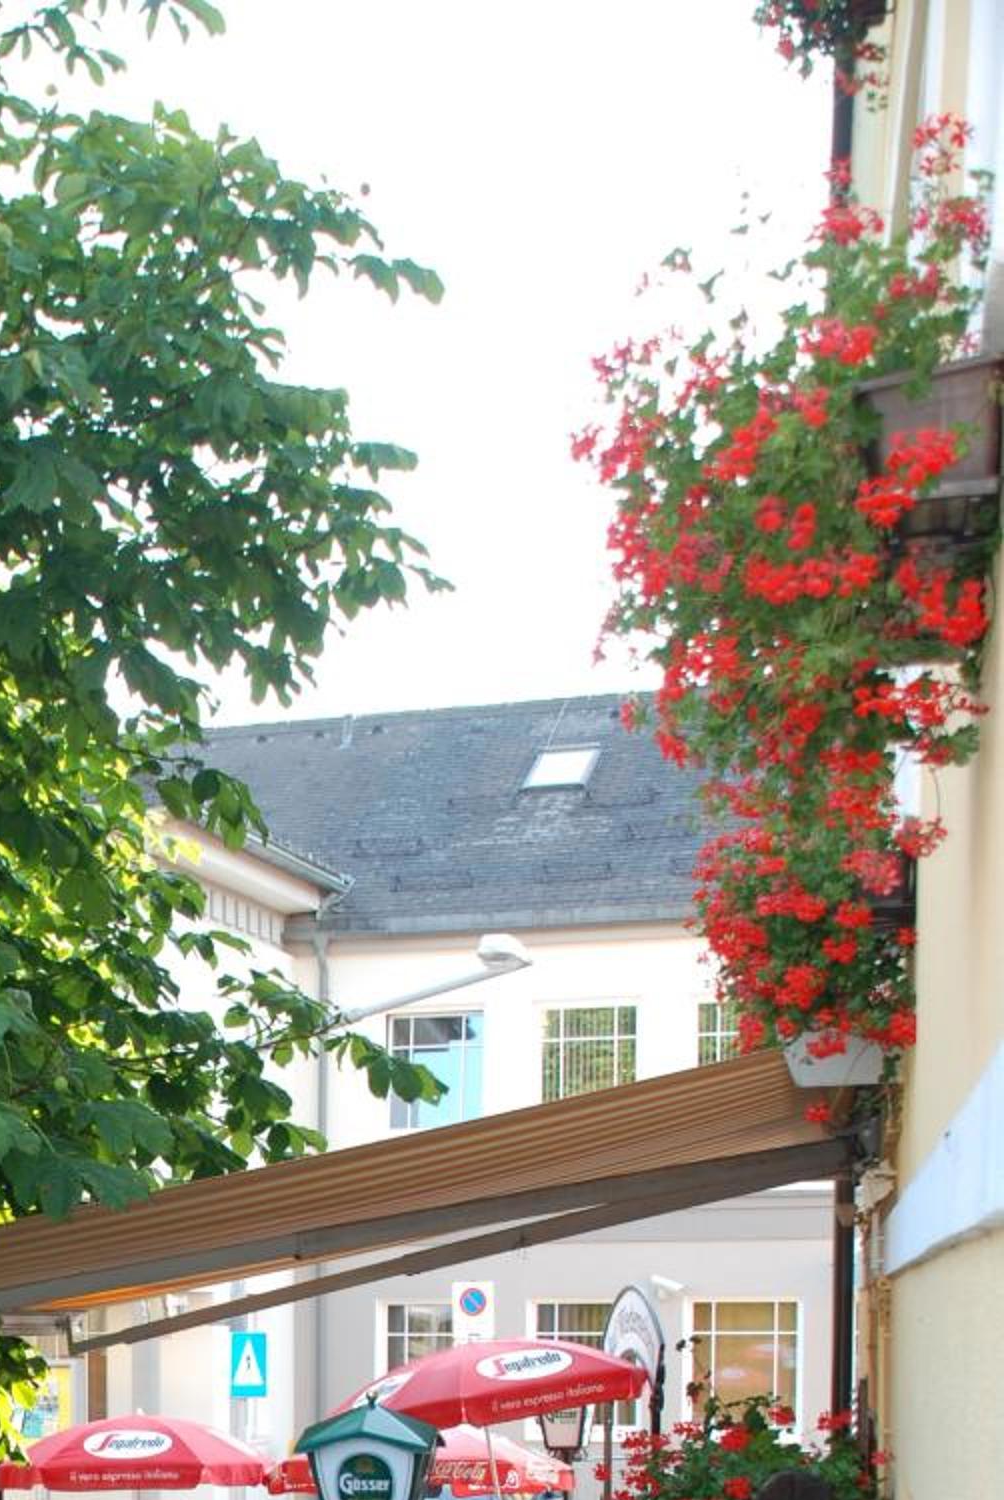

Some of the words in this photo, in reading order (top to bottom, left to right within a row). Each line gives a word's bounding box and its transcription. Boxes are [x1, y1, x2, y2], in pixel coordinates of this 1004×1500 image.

[491, 1351, 562, 1377] Segafredo
[524, 1391, 565, 1407] espresso
[566, 1383, 605, 1397] italiano
[91, 1433, 166, 1452] Segafredo
